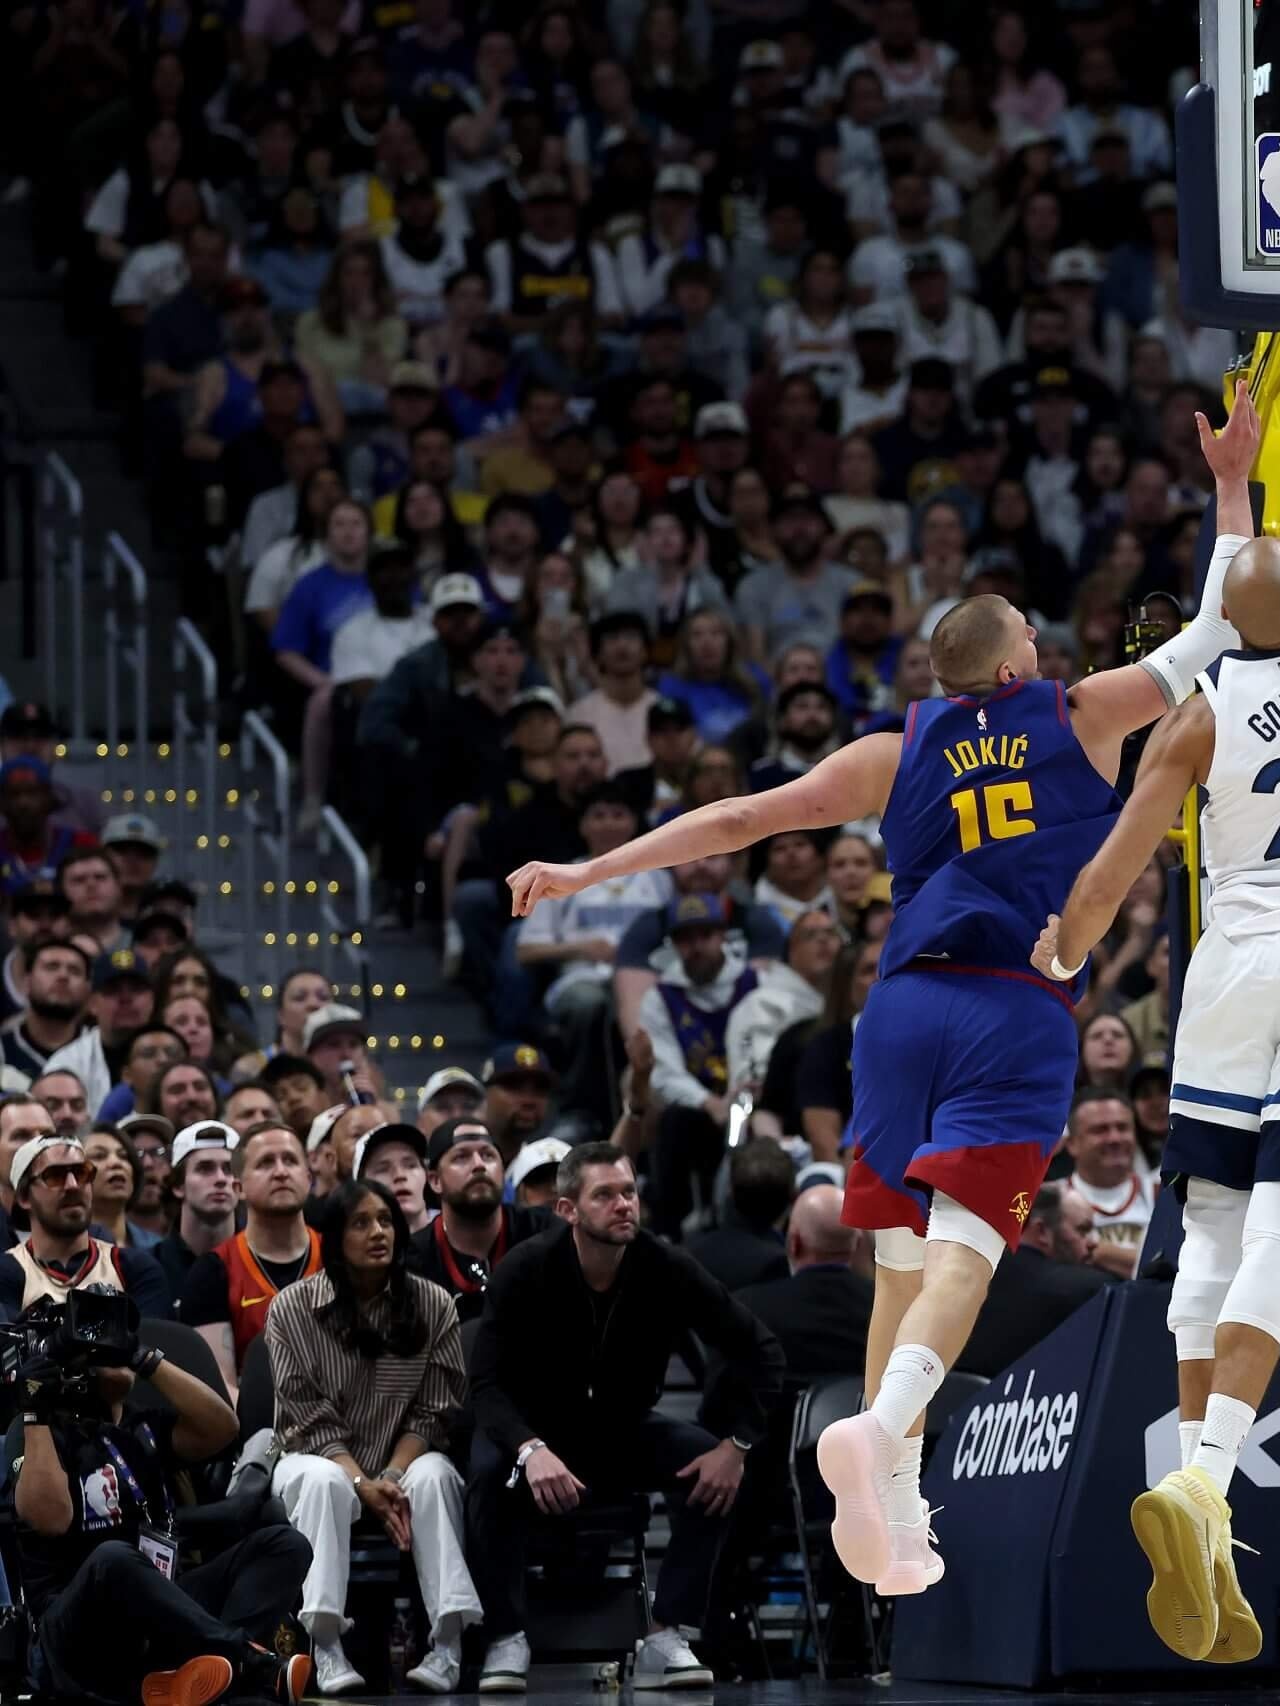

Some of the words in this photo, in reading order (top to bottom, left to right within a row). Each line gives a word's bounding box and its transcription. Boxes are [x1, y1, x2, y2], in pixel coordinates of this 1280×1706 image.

[943, 733, 1029, 778] JOKIĆ
[950, 780, 1037, 854] 15
[952, 1369, 1079, 1481] coinbase
